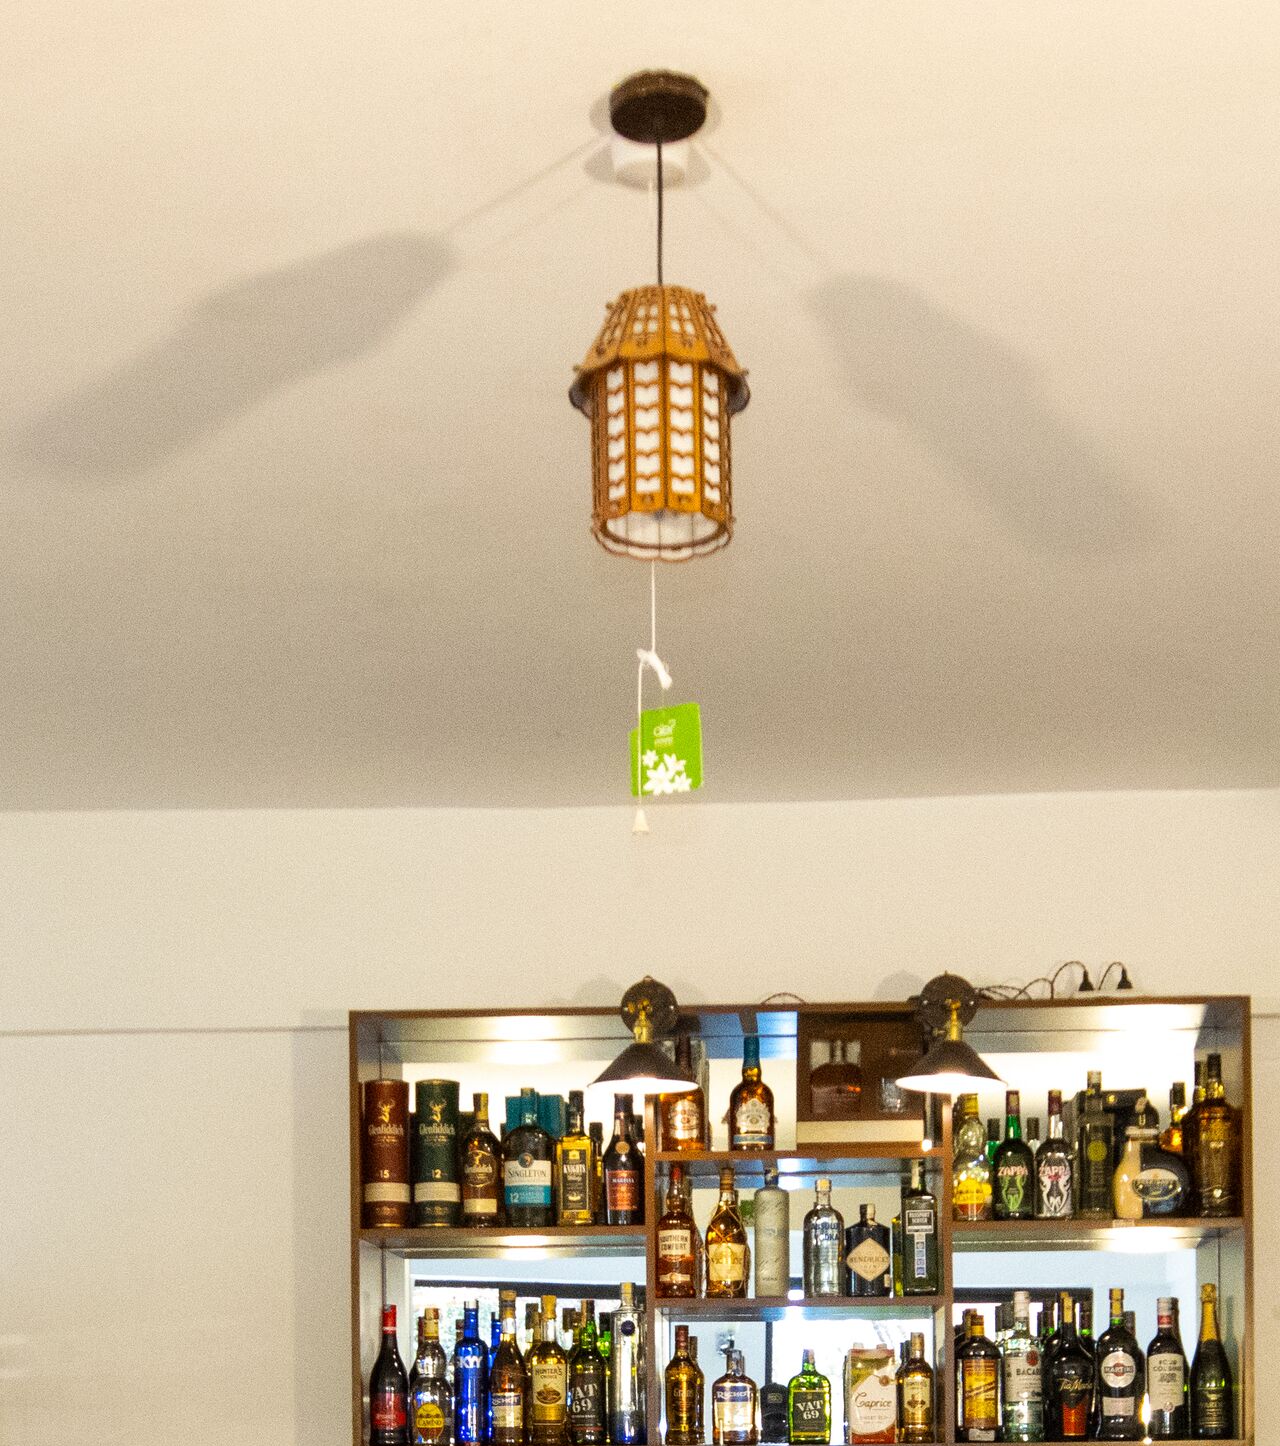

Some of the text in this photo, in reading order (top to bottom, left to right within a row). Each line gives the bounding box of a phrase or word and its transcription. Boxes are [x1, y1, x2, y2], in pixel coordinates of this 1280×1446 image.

[379, 1169, 390, 1179] 15
[431, 1169, 442, 1179] 12
[507, 1168, 547, 1179] SINGLETON
[997, 1166, 1028, 1176] ZAPPA
[1039, 1166, 1071, 1176] ZAPPA
[510, 1193, 519, 1203] 12
[660, 1235, 688, 1243] SOUTHERN
[661, 1243, 687, 1251] COMFORT
[572, 1398, 592, 1413] 69
[796, 1399, 824, 1411] VAT
[855, 1392, 892, 1409] Caprice
[802, 1410, 819, 1420] 69
